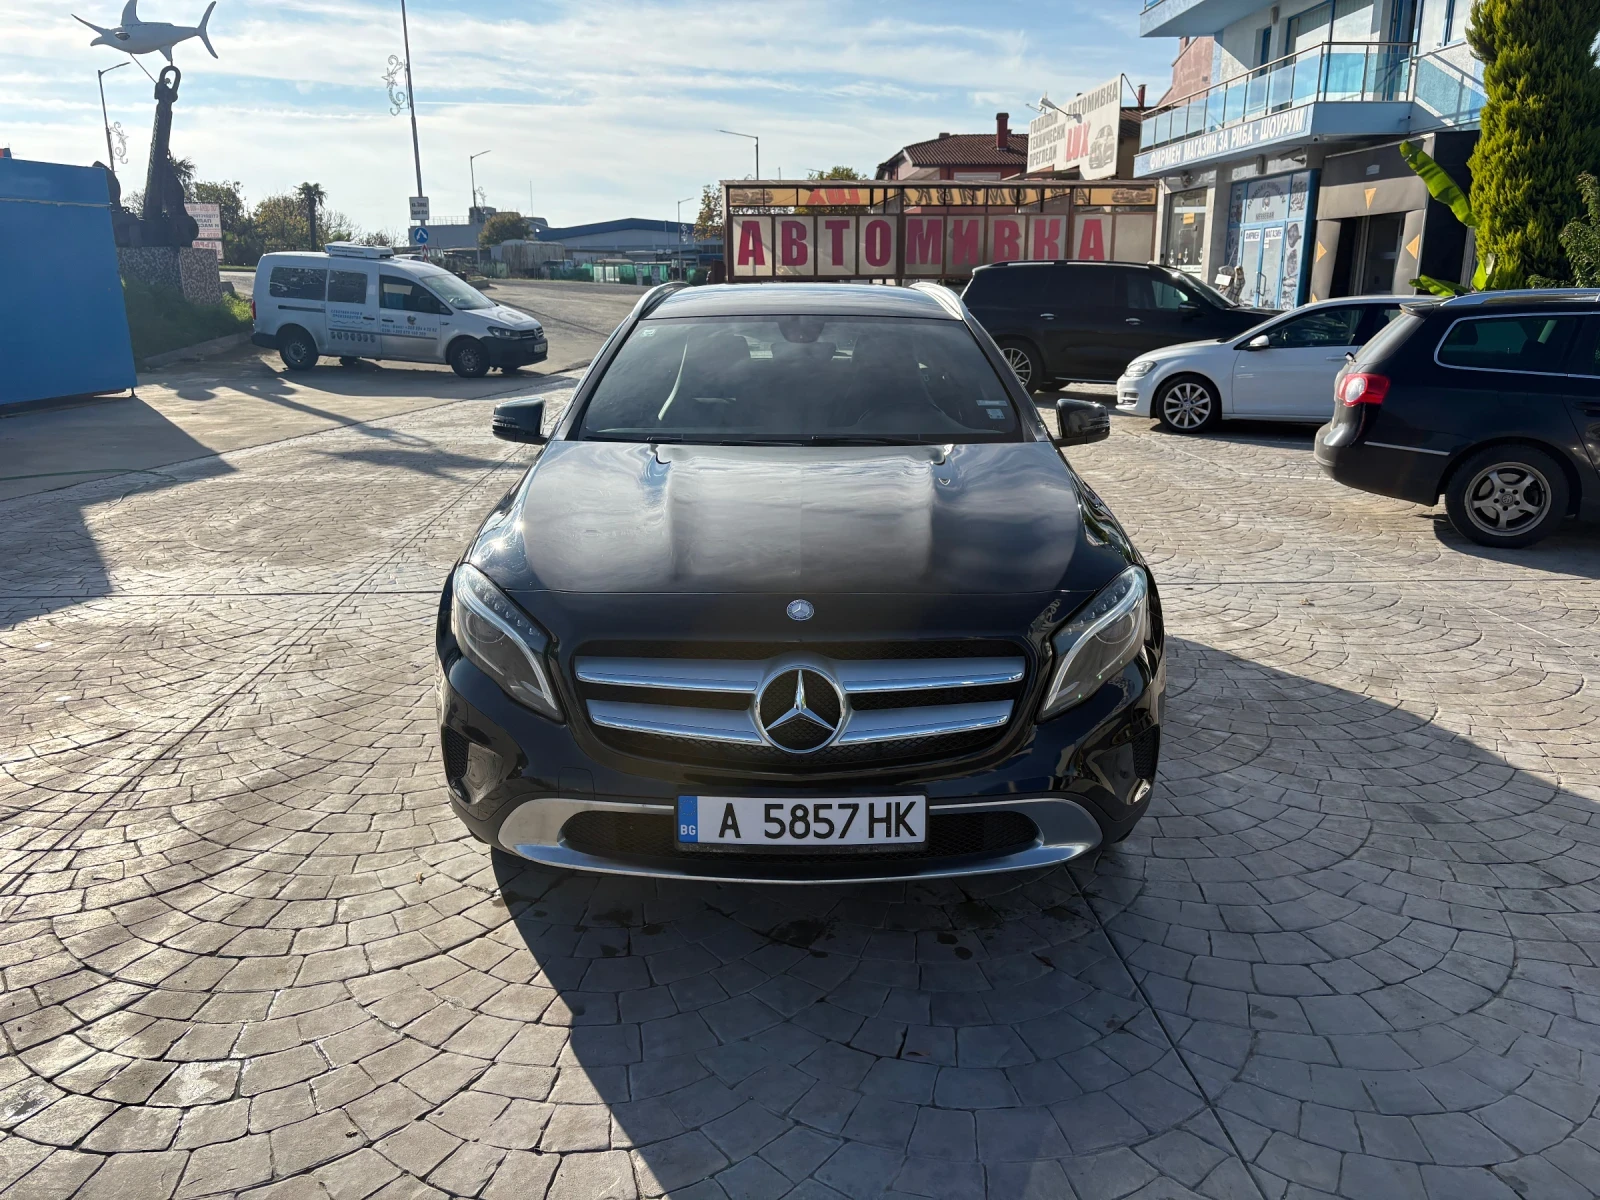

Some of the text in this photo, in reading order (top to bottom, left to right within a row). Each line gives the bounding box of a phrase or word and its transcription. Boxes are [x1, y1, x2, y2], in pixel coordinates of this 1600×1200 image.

[1067, 81, 1118, 122] АВТОМИВКА
[1029, 144, 1058, 168] ПРЕГЛЕДИ
[1030, 123, 1065, 151] ТЕХНИЧЕСКИ
[1066, 120, 1091, 162] LUX
[1149, 107, 1305, 170] ФИРМЕН МАГАЗИН ЗА РИБА ШОУРУМ
[737, 219, 1105, 267] АВТОМИВКА
[680, 801, 917, 839] BG A 5857 HK
